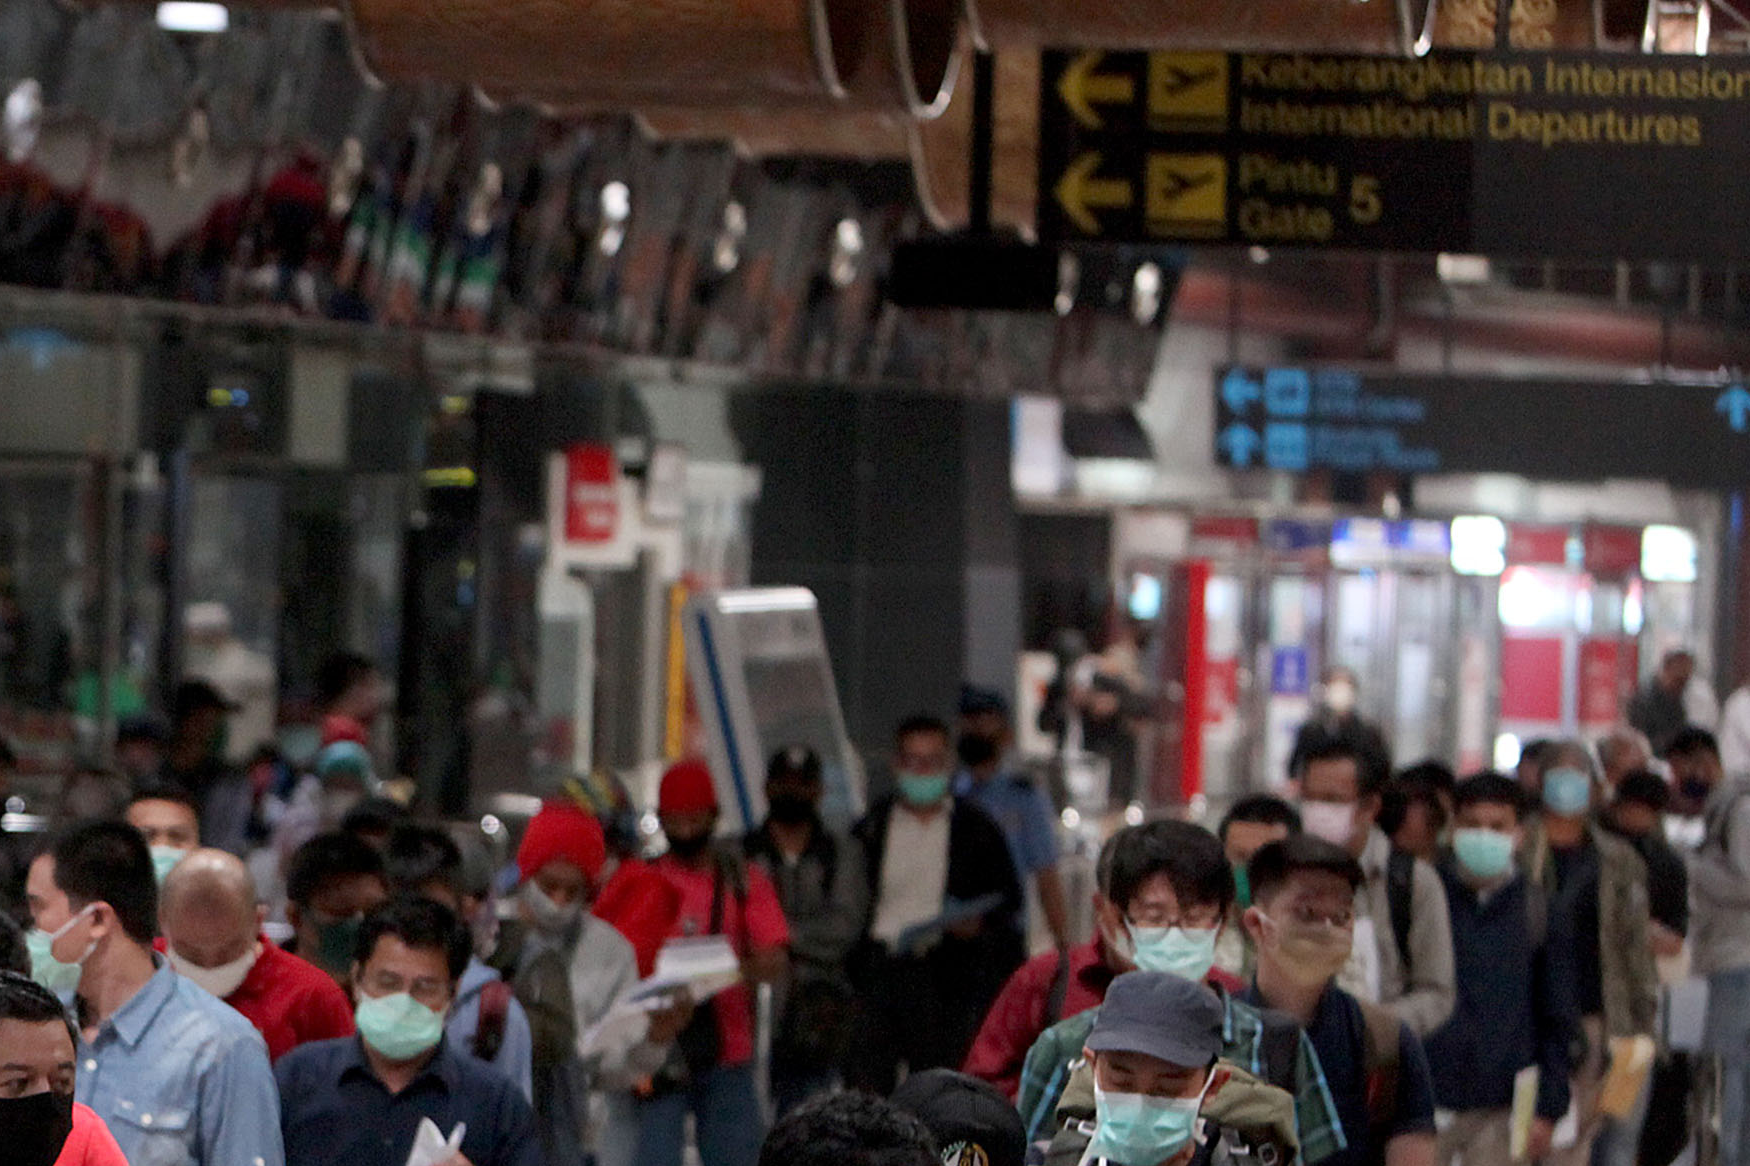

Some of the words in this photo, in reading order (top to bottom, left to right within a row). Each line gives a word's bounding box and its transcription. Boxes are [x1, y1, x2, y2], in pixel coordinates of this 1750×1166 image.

[1240, 56, 1533, 100] Keberangkatan
[1240, 99, 1475, 139] International
[1487, 101, 1701, 149] Departures
[1238, 152, 1338, 196] Pintu
[1238, 197, 1334, 240] Gate
[1349, 174, 1383, 225] 5
